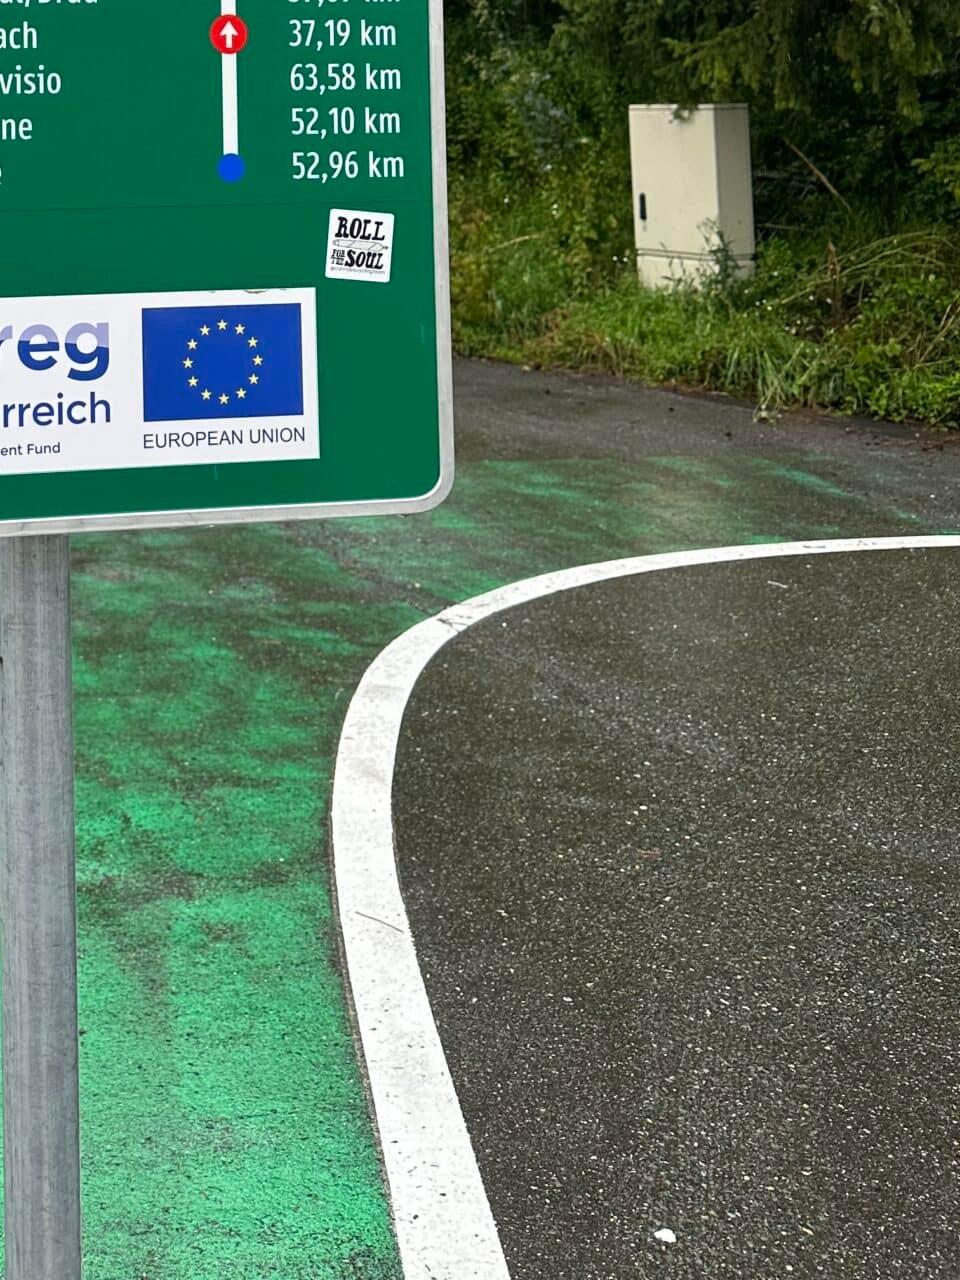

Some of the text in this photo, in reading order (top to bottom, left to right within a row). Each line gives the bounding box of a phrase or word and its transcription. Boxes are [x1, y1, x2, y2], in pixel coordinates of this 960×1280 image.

[290, 20, 395, 50] 37,19 km
[291, 63, 400, 94] 63,58 km
[292, 107, 400, 138] 52,10 km
[293, 151, 403, 183] 52,96 km
[335, 216, 385, 240] ROLL
[345, 249, 383, 269] SOUL
[27, 442, 60, 455] Fund
[144, 427, 305, 449] EUROPEAN UNION
